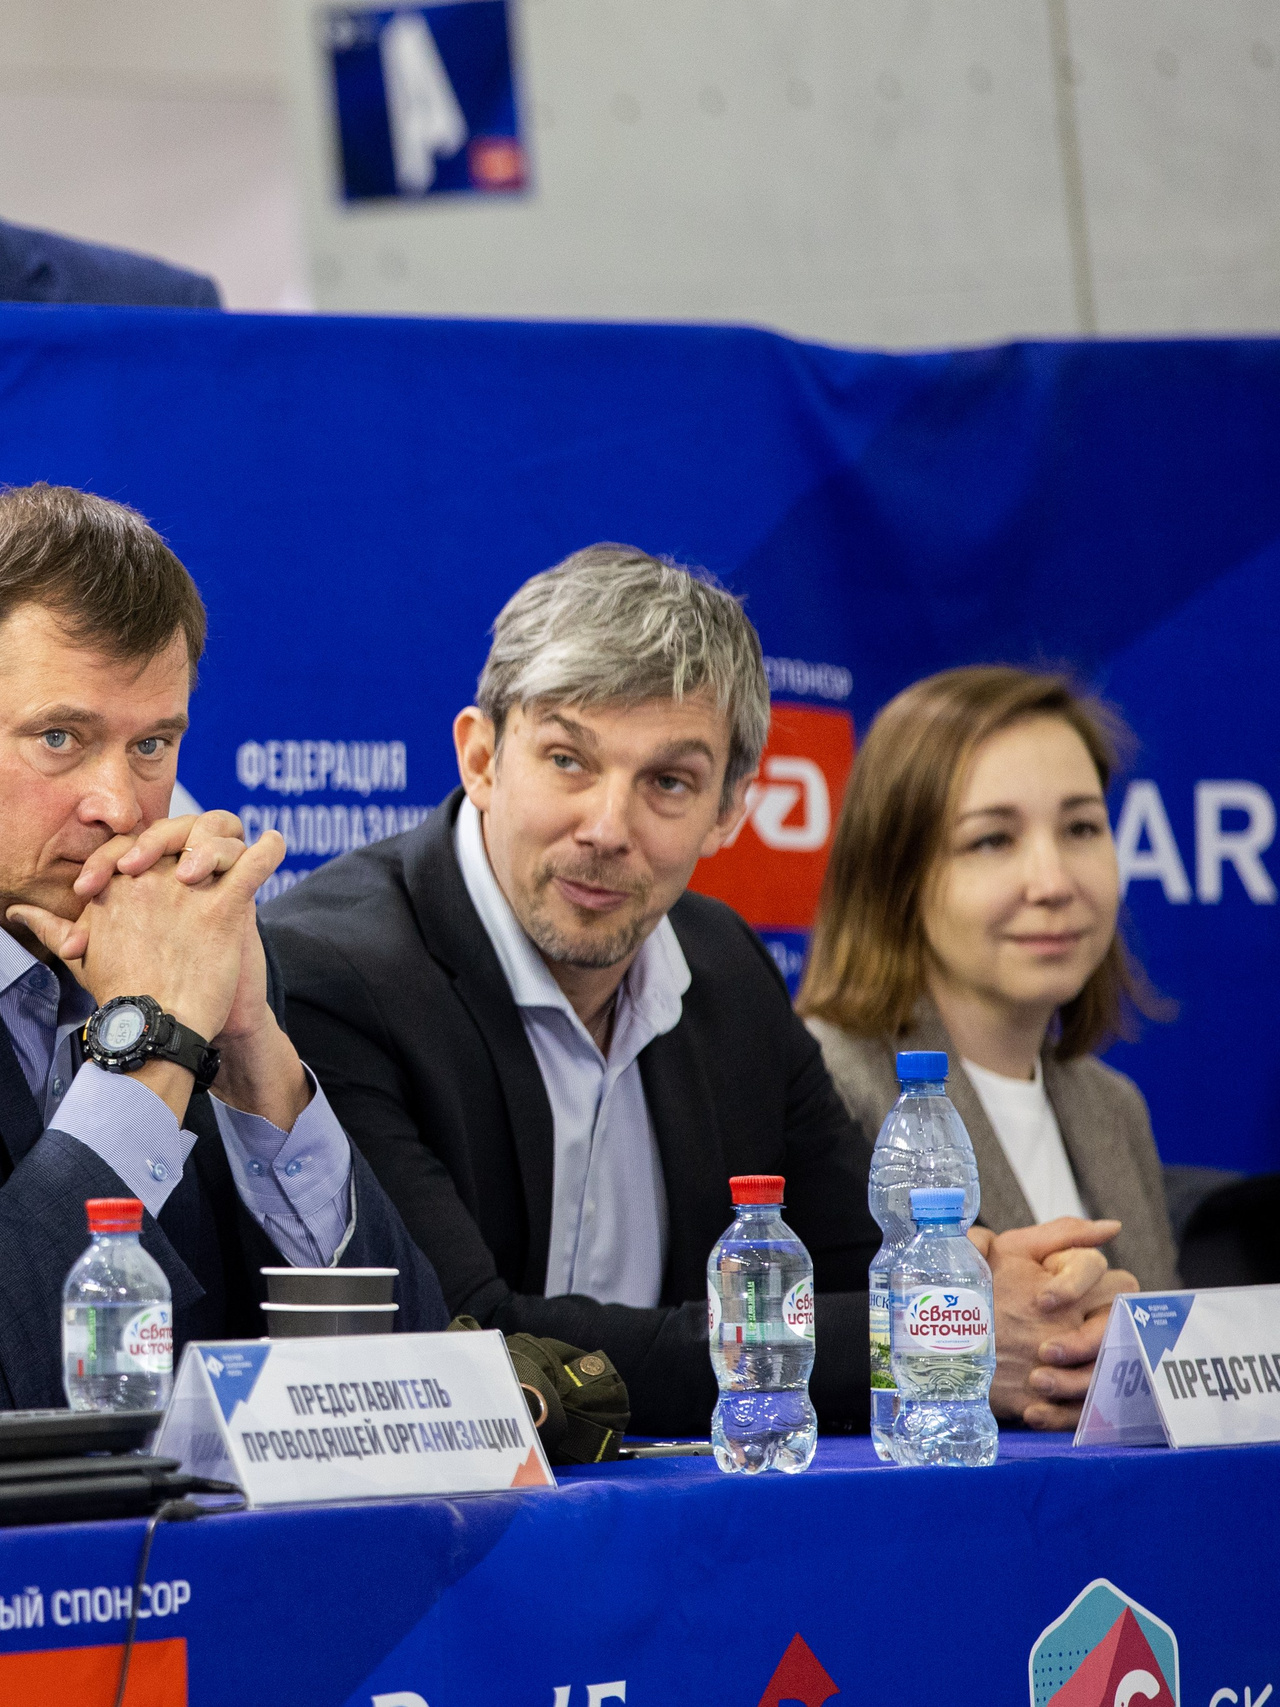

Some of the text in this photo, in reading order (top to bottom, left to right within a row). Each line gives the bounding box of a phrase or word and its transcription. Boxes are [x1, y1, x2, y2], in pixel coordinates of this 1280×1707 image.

[236, 741, 407, 796] ФЕДЕРАЦИЯ
[286, 1378, 452, 1416] ПРЕДСТАВИТЕЛЬ
[242, 1419, 381, 1463] ПРОВОДЯЩЕЙ
[384, 1418, 526, 1457] ОРГАНИЗАЦИИ
[51, 1579, 191, 1627] СПОНСОР
